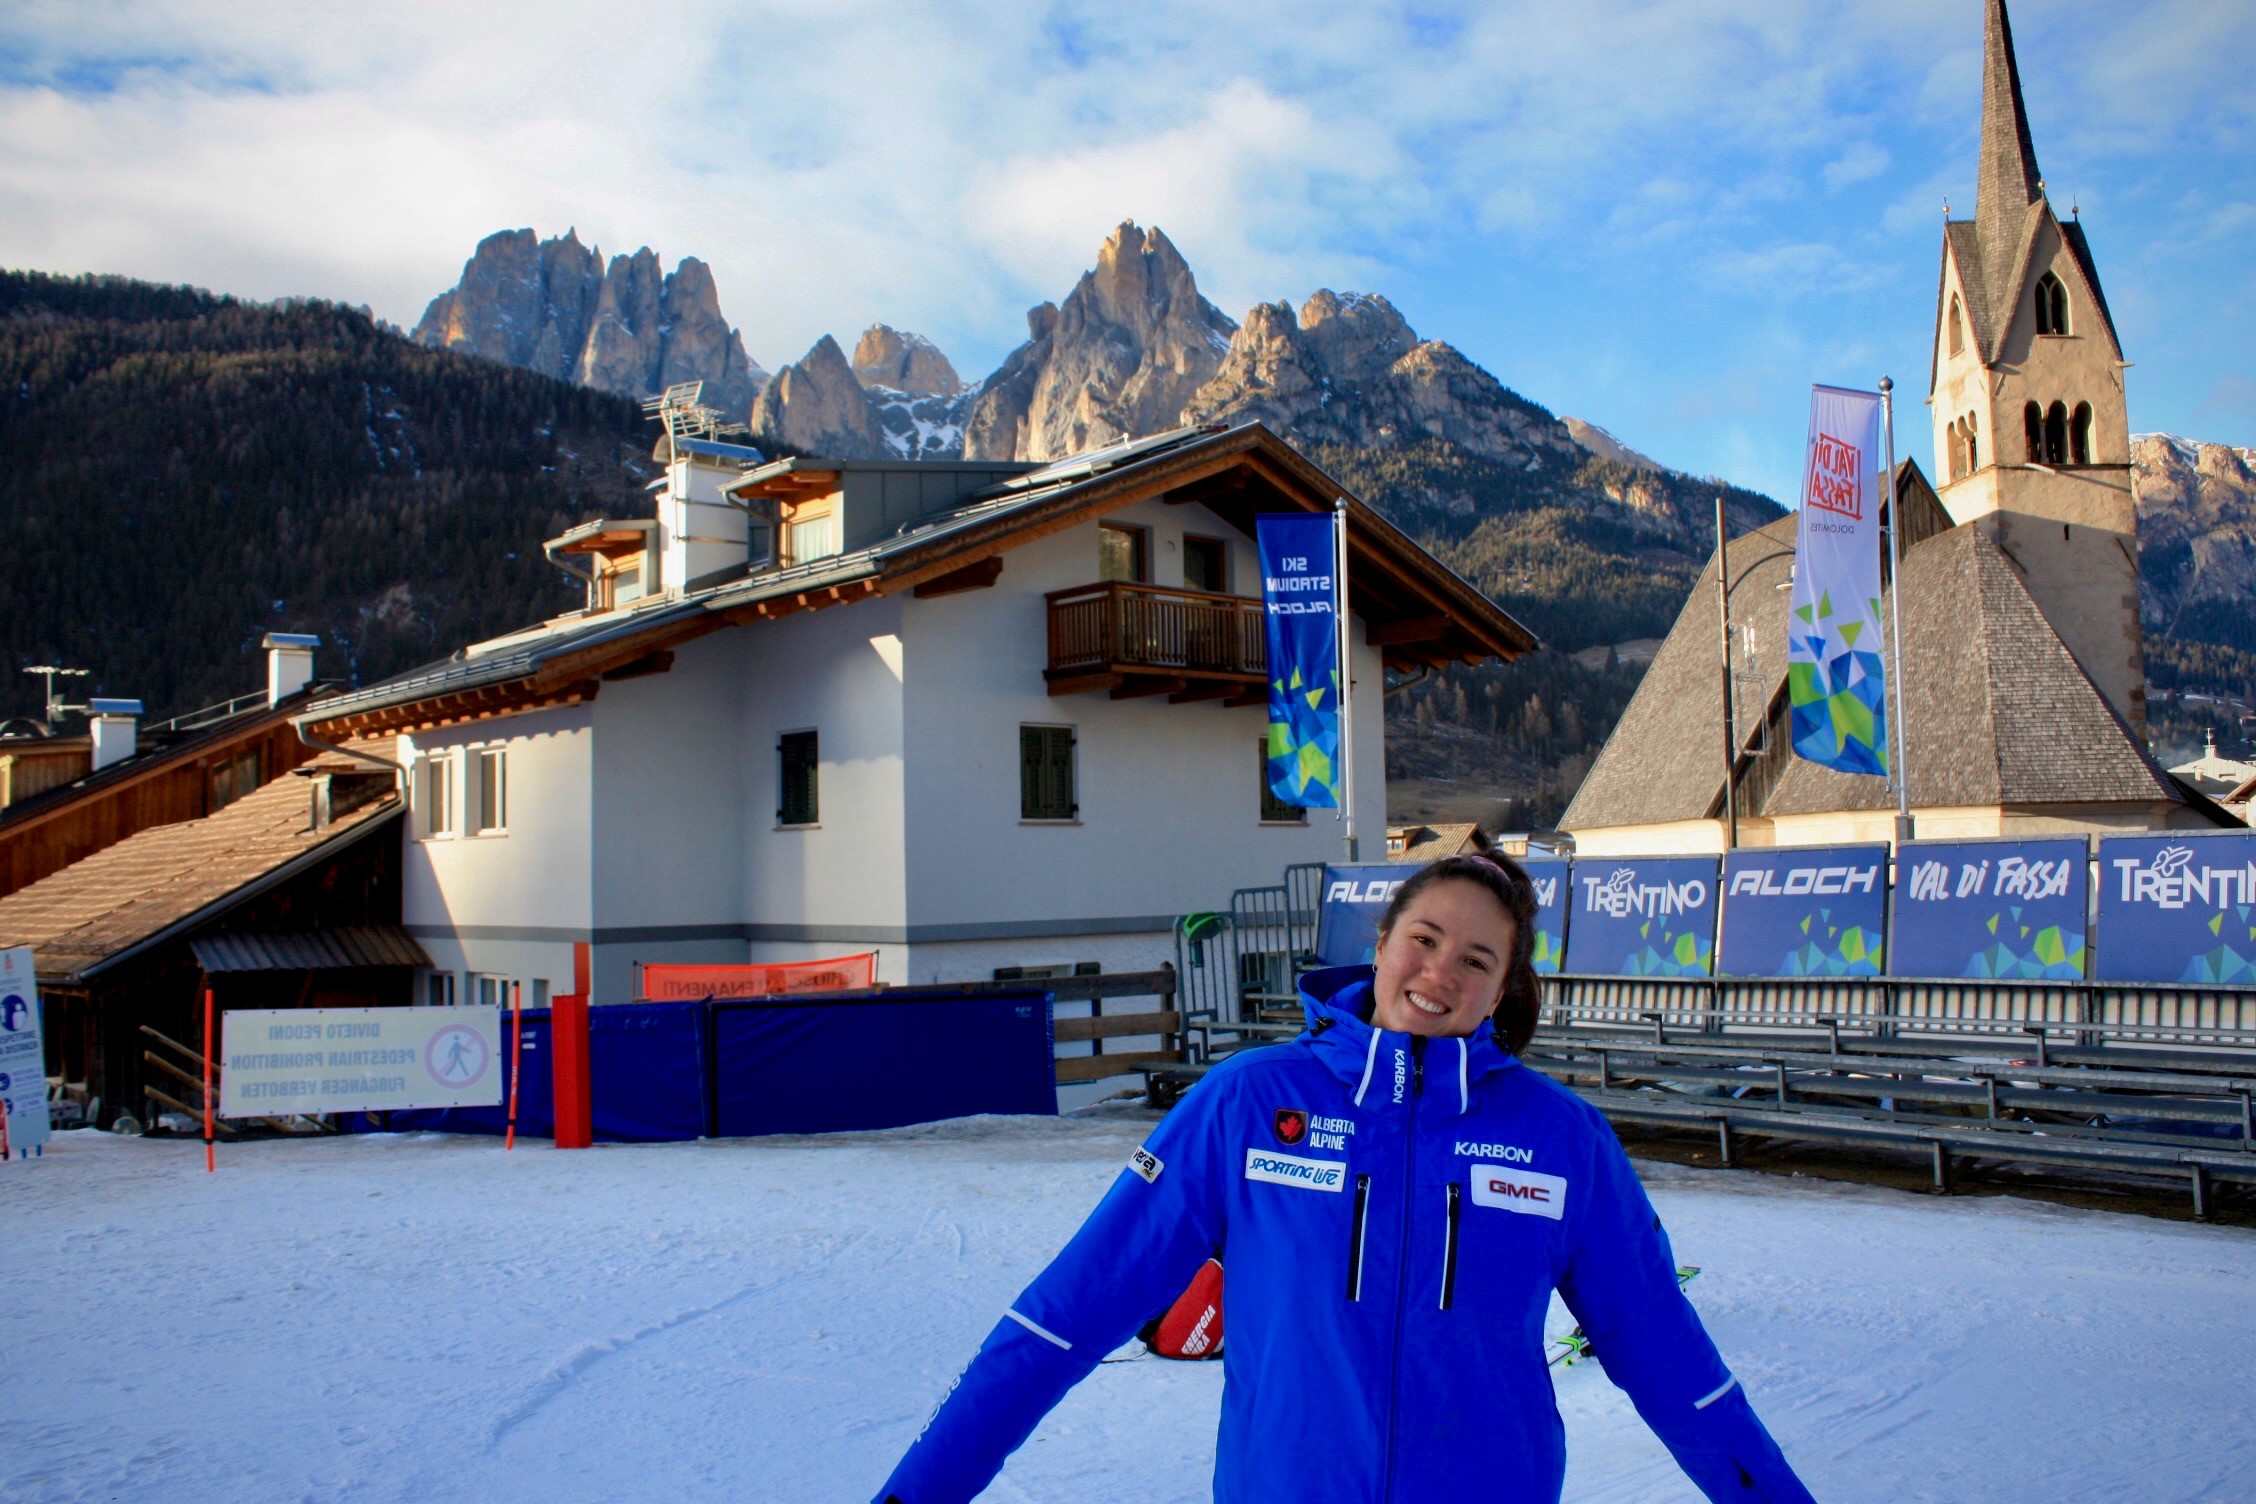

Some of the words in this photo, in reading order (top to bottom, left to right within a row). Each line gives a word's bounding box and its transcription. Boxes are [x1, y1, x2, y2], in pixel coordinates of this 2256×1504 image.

[1326, 880, 1404, 903] ALOC
[1728, 865, 1878, 896] ALOCH
[1909, 861, 1950, 900] VAL
[1997, 857, 2071, 900] FASSA
[1582, 876, 1706, 919] TRENTINO
[1392, 1048, 1406, 1104] KARBON
[1310, 1114, 1356, 1136] ALBERTA
[1309, 1131, 1345, 1151] ALPINE
[1453, 1141, 1533, 1164] KARBON
[1488, 1179, 1550, 1203] GMC
[1180, 1304, 1217, 1355] ENERGIA
